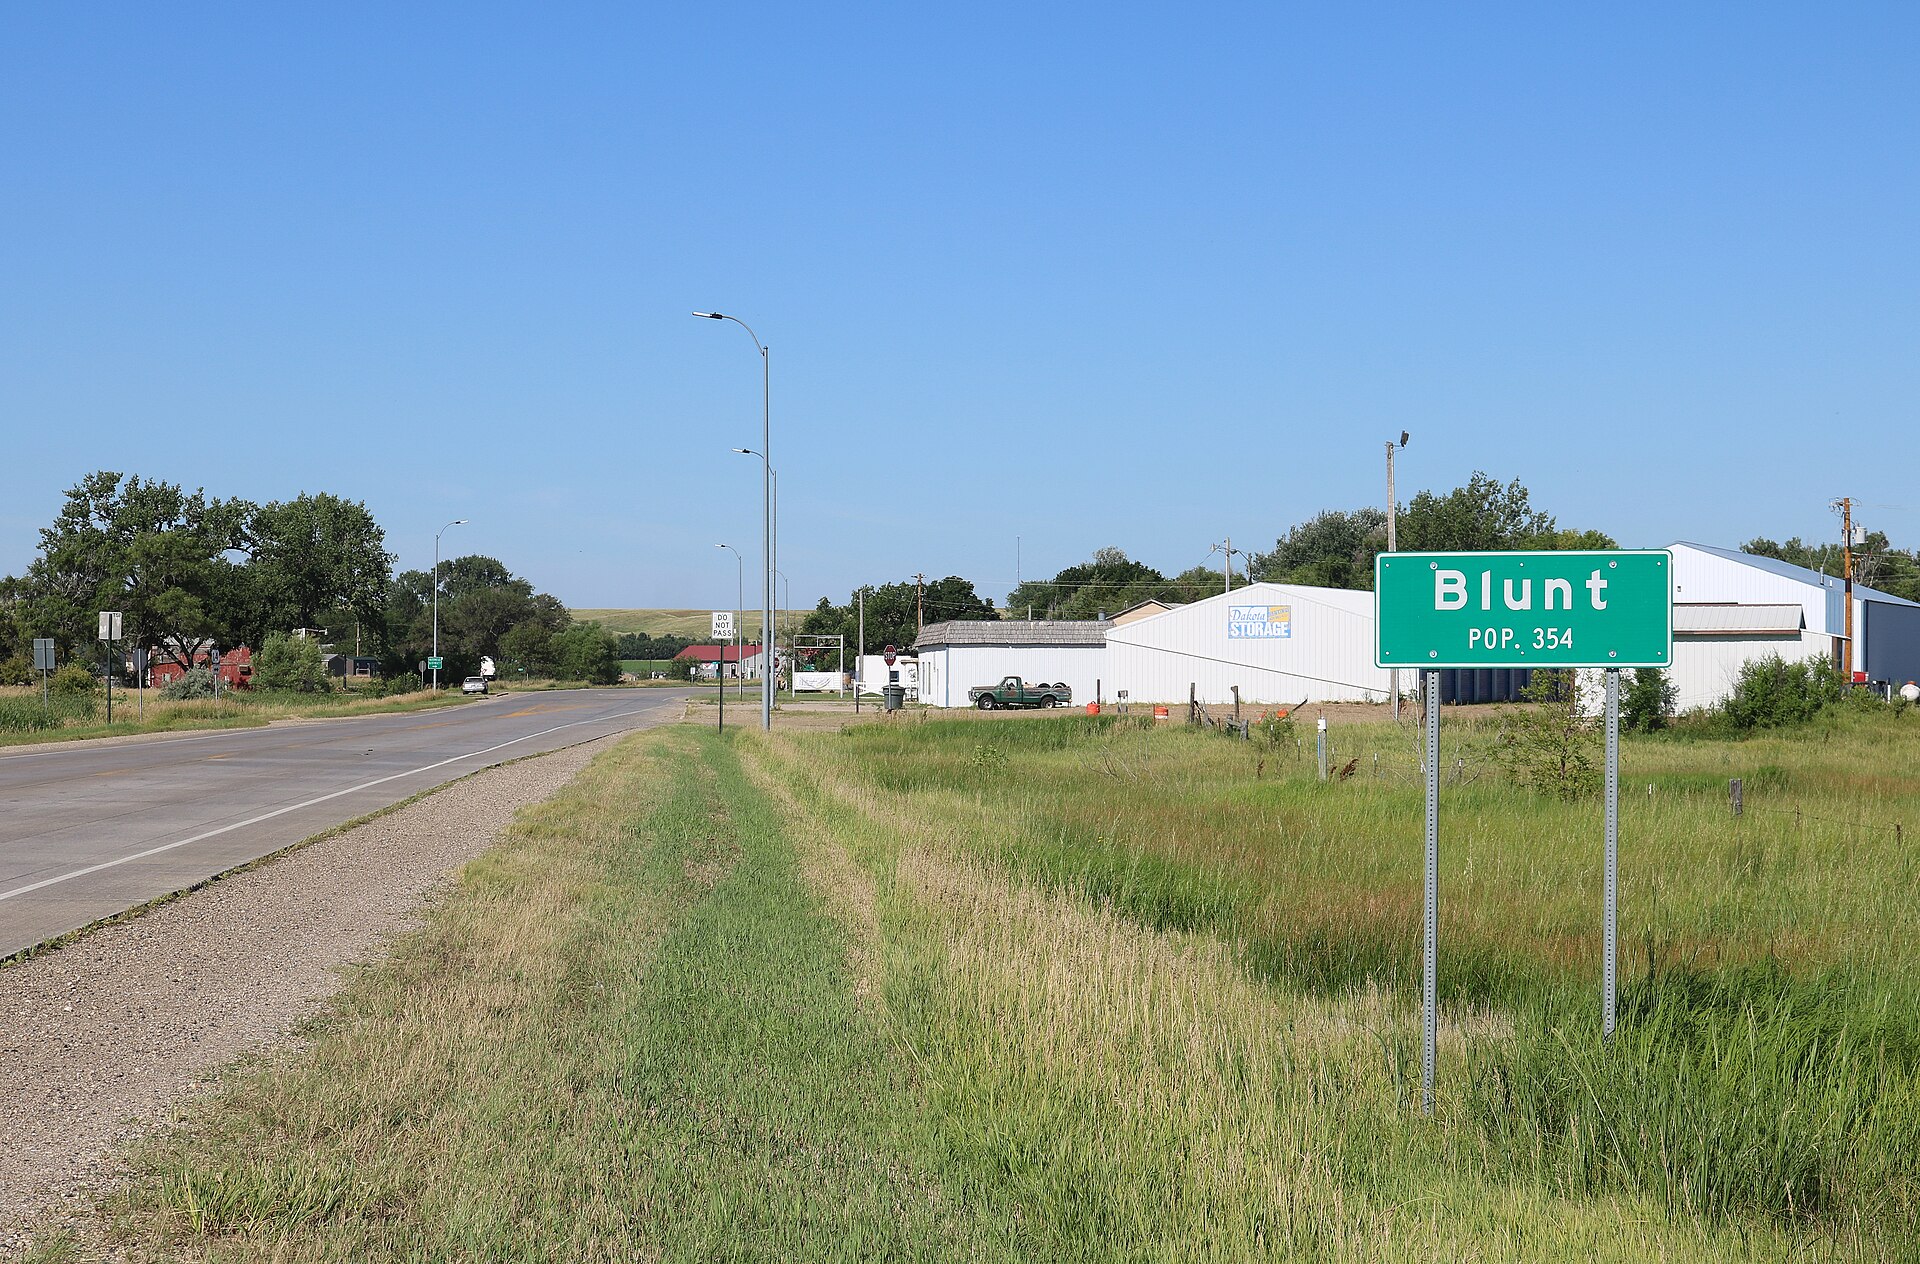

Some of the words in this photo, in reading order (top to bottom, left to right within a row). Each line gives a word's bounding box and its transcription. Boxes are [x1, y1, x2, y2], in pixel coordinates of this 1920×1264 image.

[1435, 569, 1608, 611] Blunt
[1230, 606, 1265, 620] Dakota
[1230, 622, 1289, 636] STORAGE
[1469, 628, 1521, 649] POP.
[1532, 628, 1573, 649] 354
[884, 651, 896, 660] STOP
